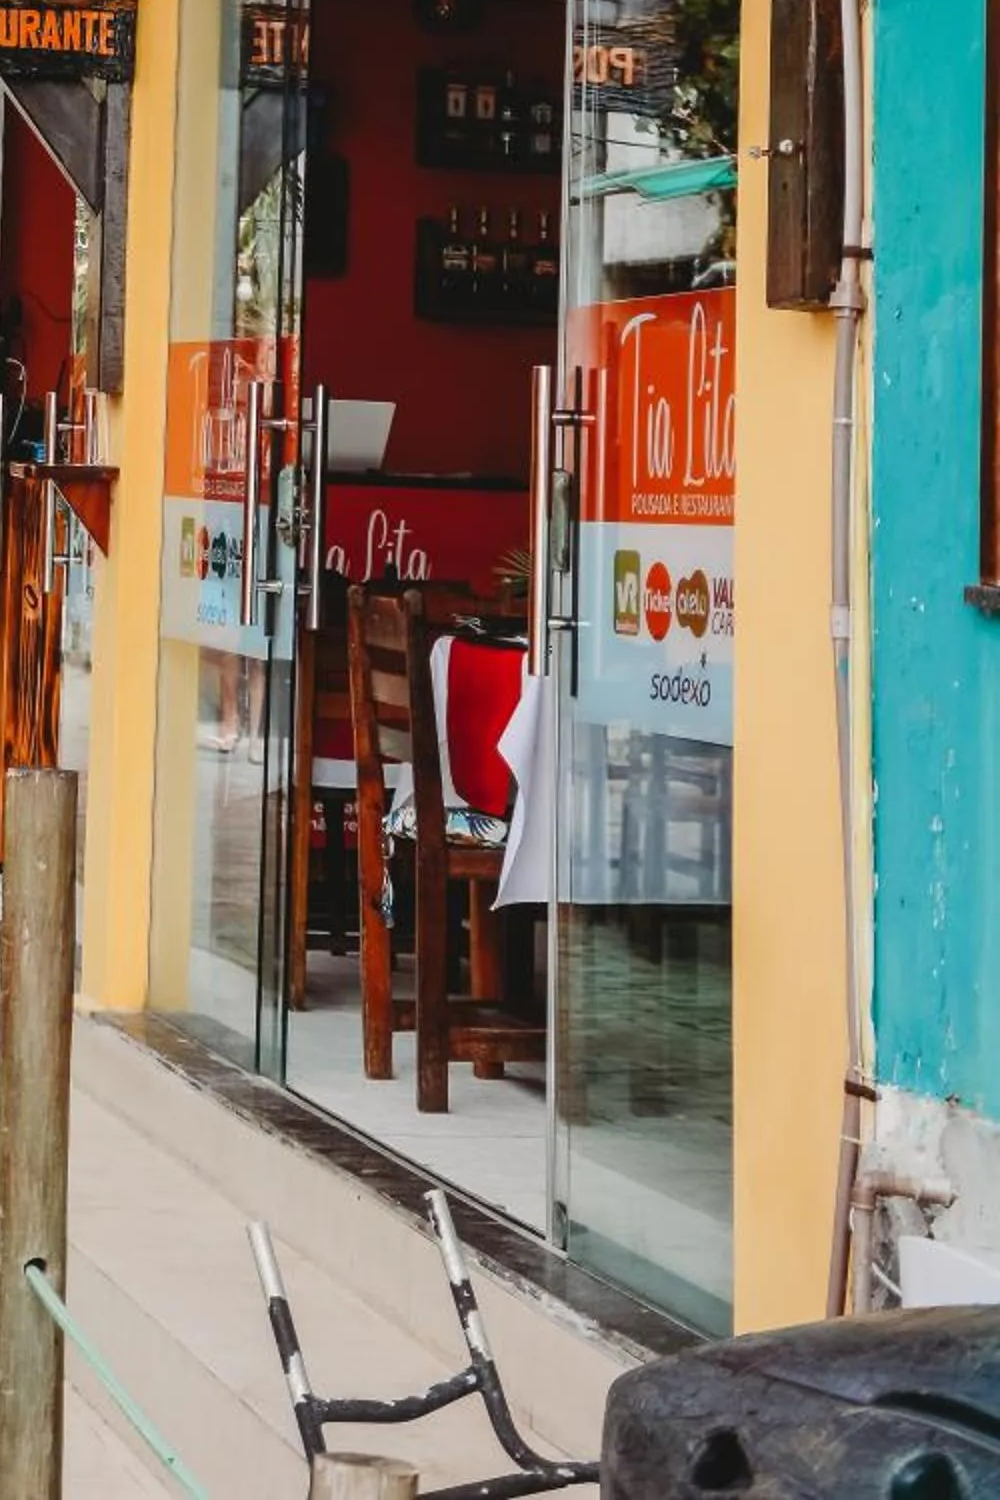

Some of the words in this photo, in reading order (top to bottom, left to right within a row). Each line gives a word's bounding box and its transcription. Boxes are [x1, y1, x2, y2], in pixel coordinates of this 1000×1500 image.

[621, 312, 675, 489] Tia
[631, 493, 671, 516] POUSADA
[649, 665, 712, 708] sodexo
